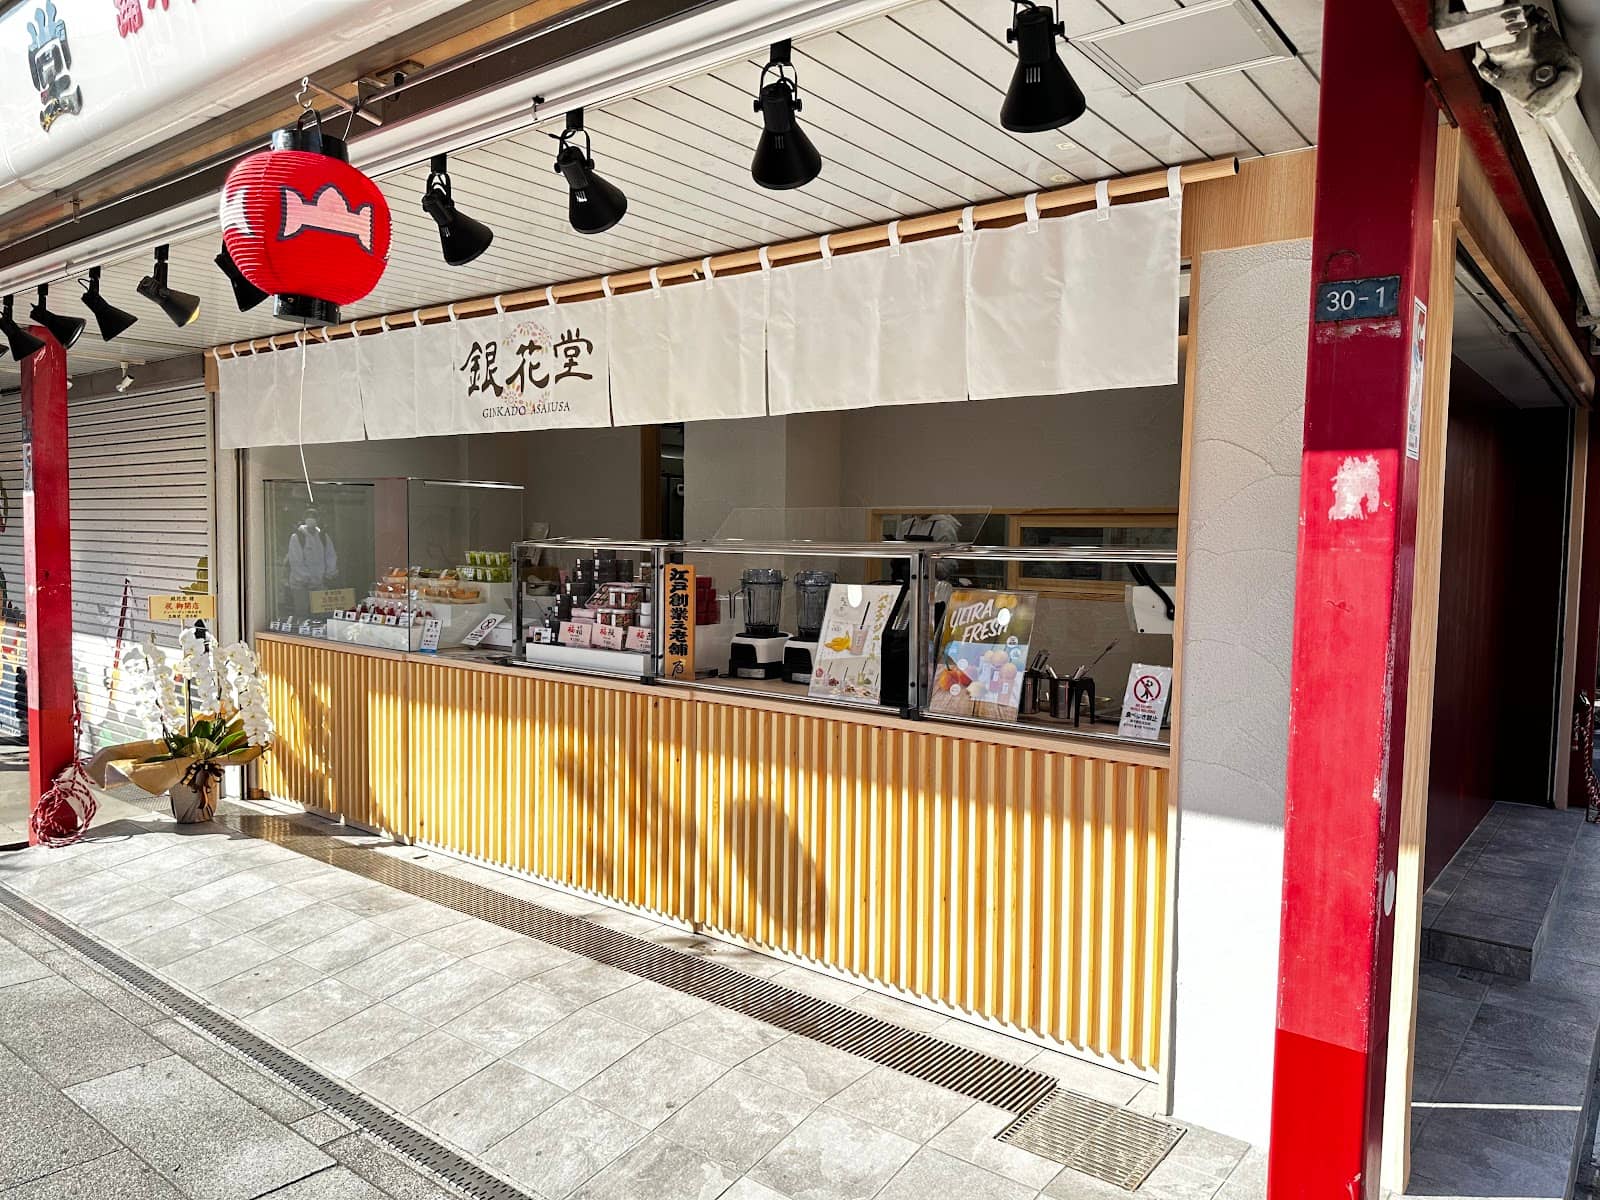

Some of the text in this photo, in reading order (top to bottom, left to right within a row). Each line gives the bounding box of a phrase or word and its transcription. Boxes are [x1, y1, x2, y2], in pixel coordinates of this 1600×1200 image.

[1326, 286, 1385, 312] 30-1
[460, 328, 594, 397] 銀花堂
[950, 599, 994, 634] ULTRA
